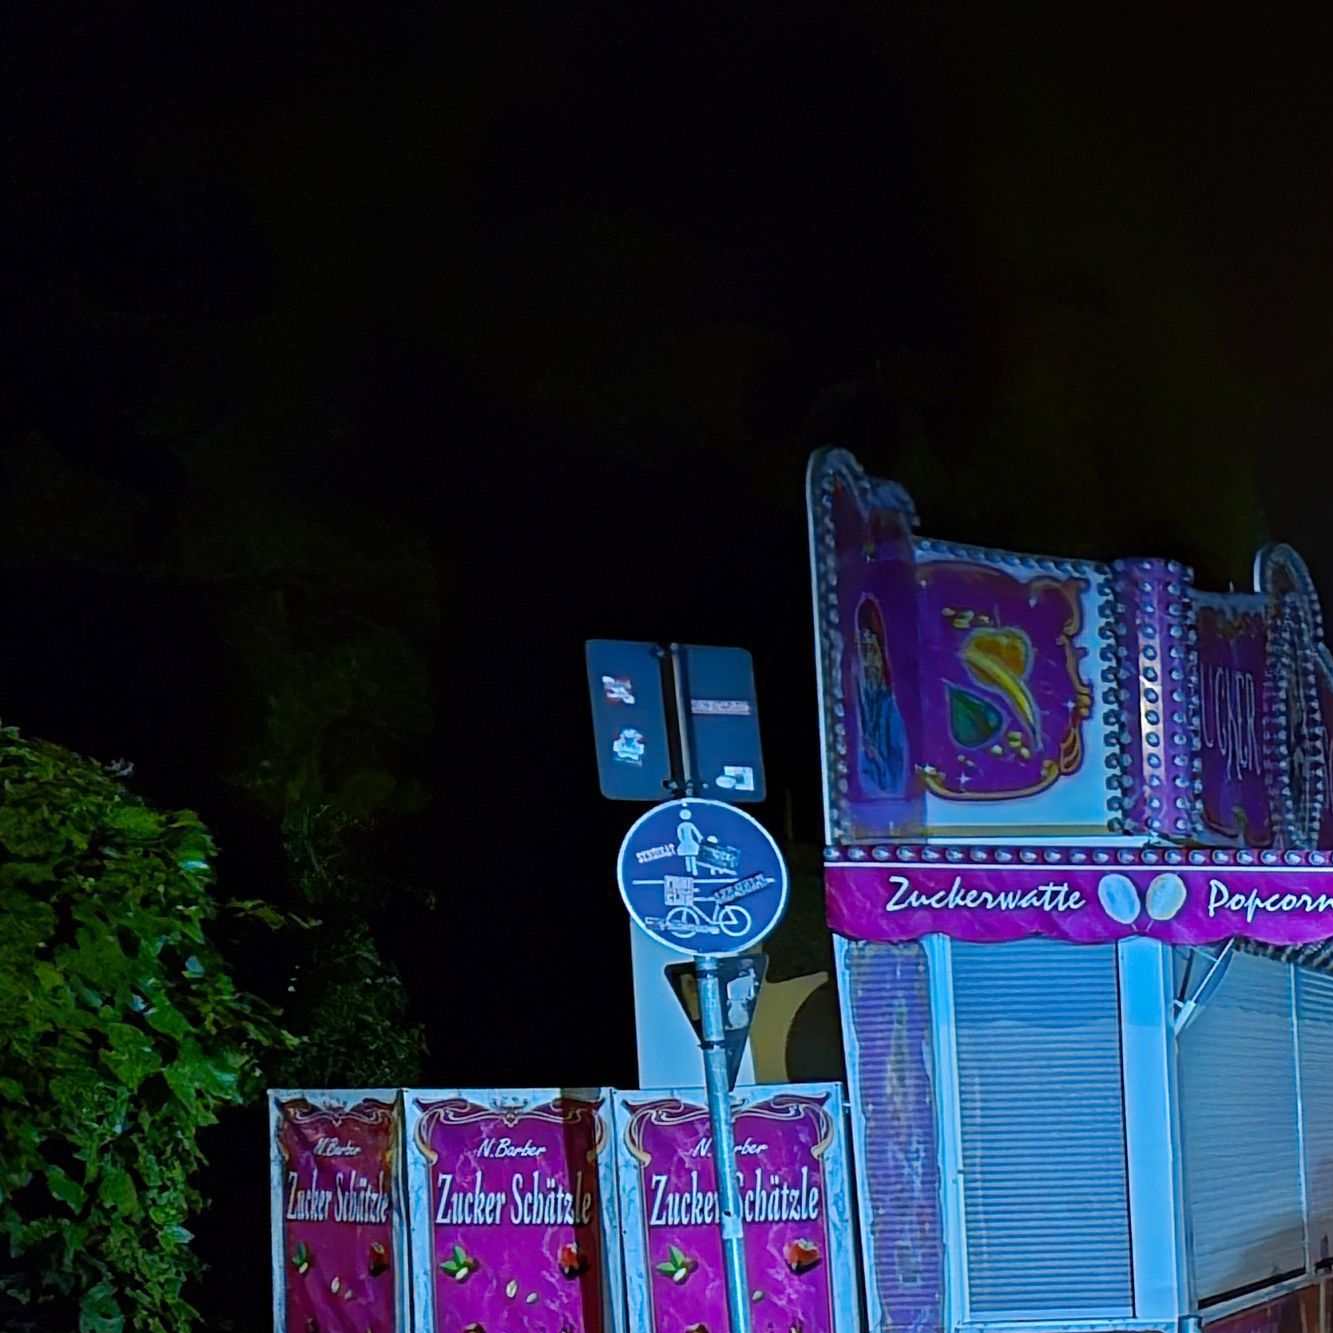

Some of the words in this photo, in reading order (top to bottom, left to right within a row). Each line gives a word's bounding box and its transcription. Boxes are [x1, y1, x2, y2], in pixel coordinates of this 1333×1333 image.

[886, 876, 1086, 912] Zuckerwatte
[287, 1169, 333, 1222] Zucker
[334, 1169, 390, 1224] Schätzle
[435, 1169, 506, 1225] Zucker
[510, 1168, 592, 1225] Schätzle
